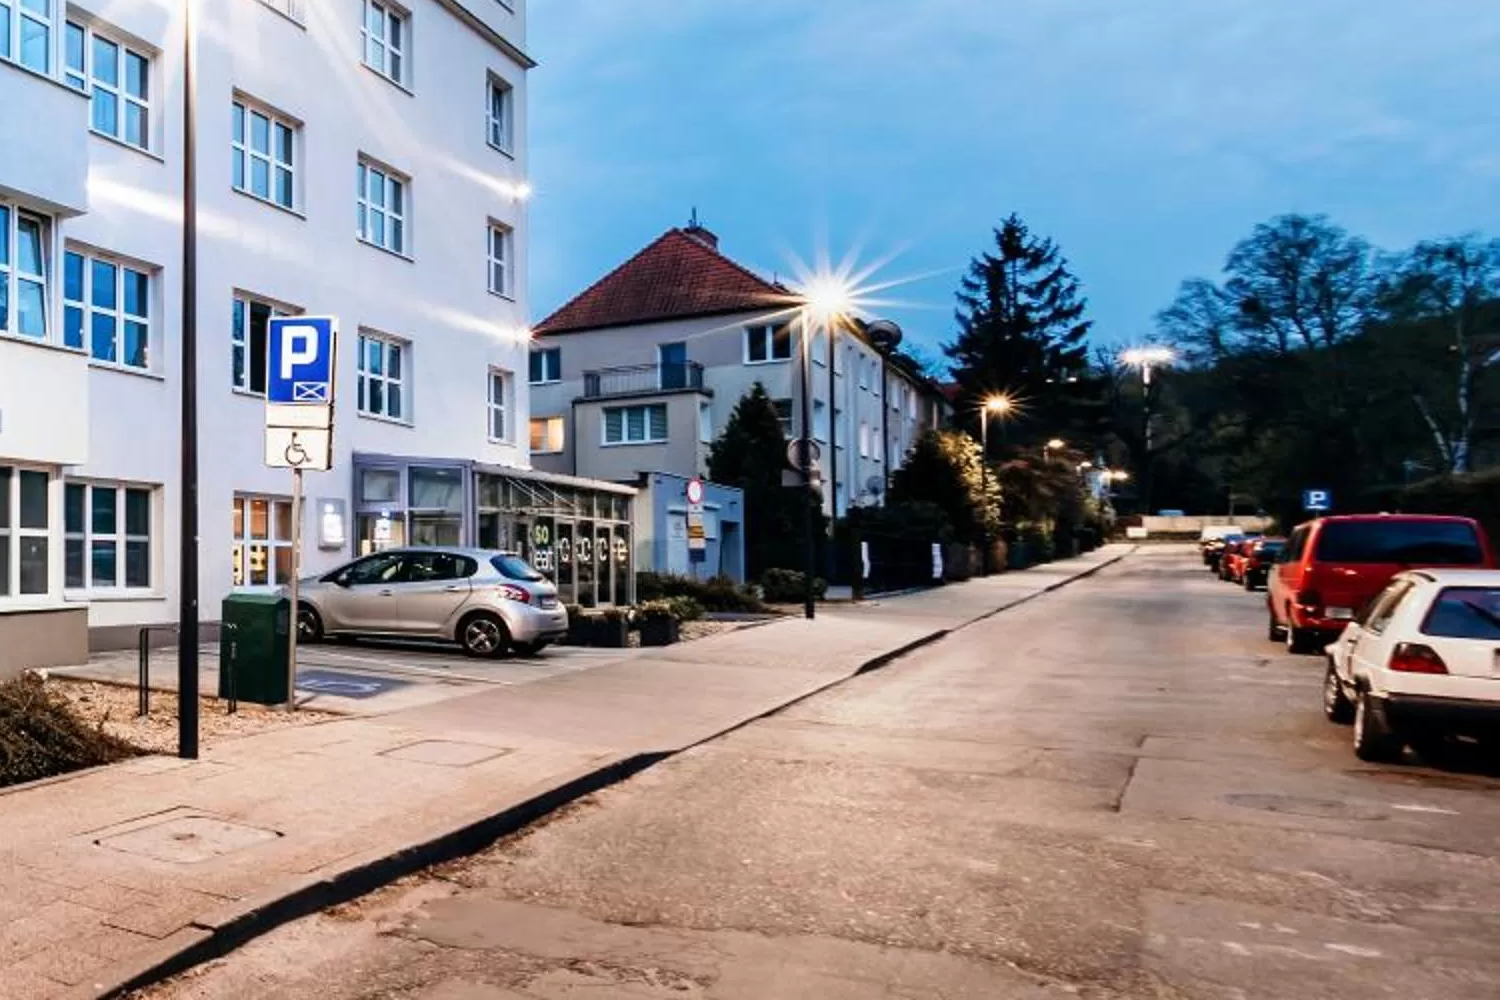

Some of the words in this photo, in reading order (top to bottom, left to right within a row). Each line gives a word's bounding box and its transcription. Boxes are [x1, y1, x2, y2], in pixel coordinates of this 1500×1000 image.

[281, 325, 318, 379] P
[1309, 491, 1326, 505] P
[534, 525, 549, 545] so
